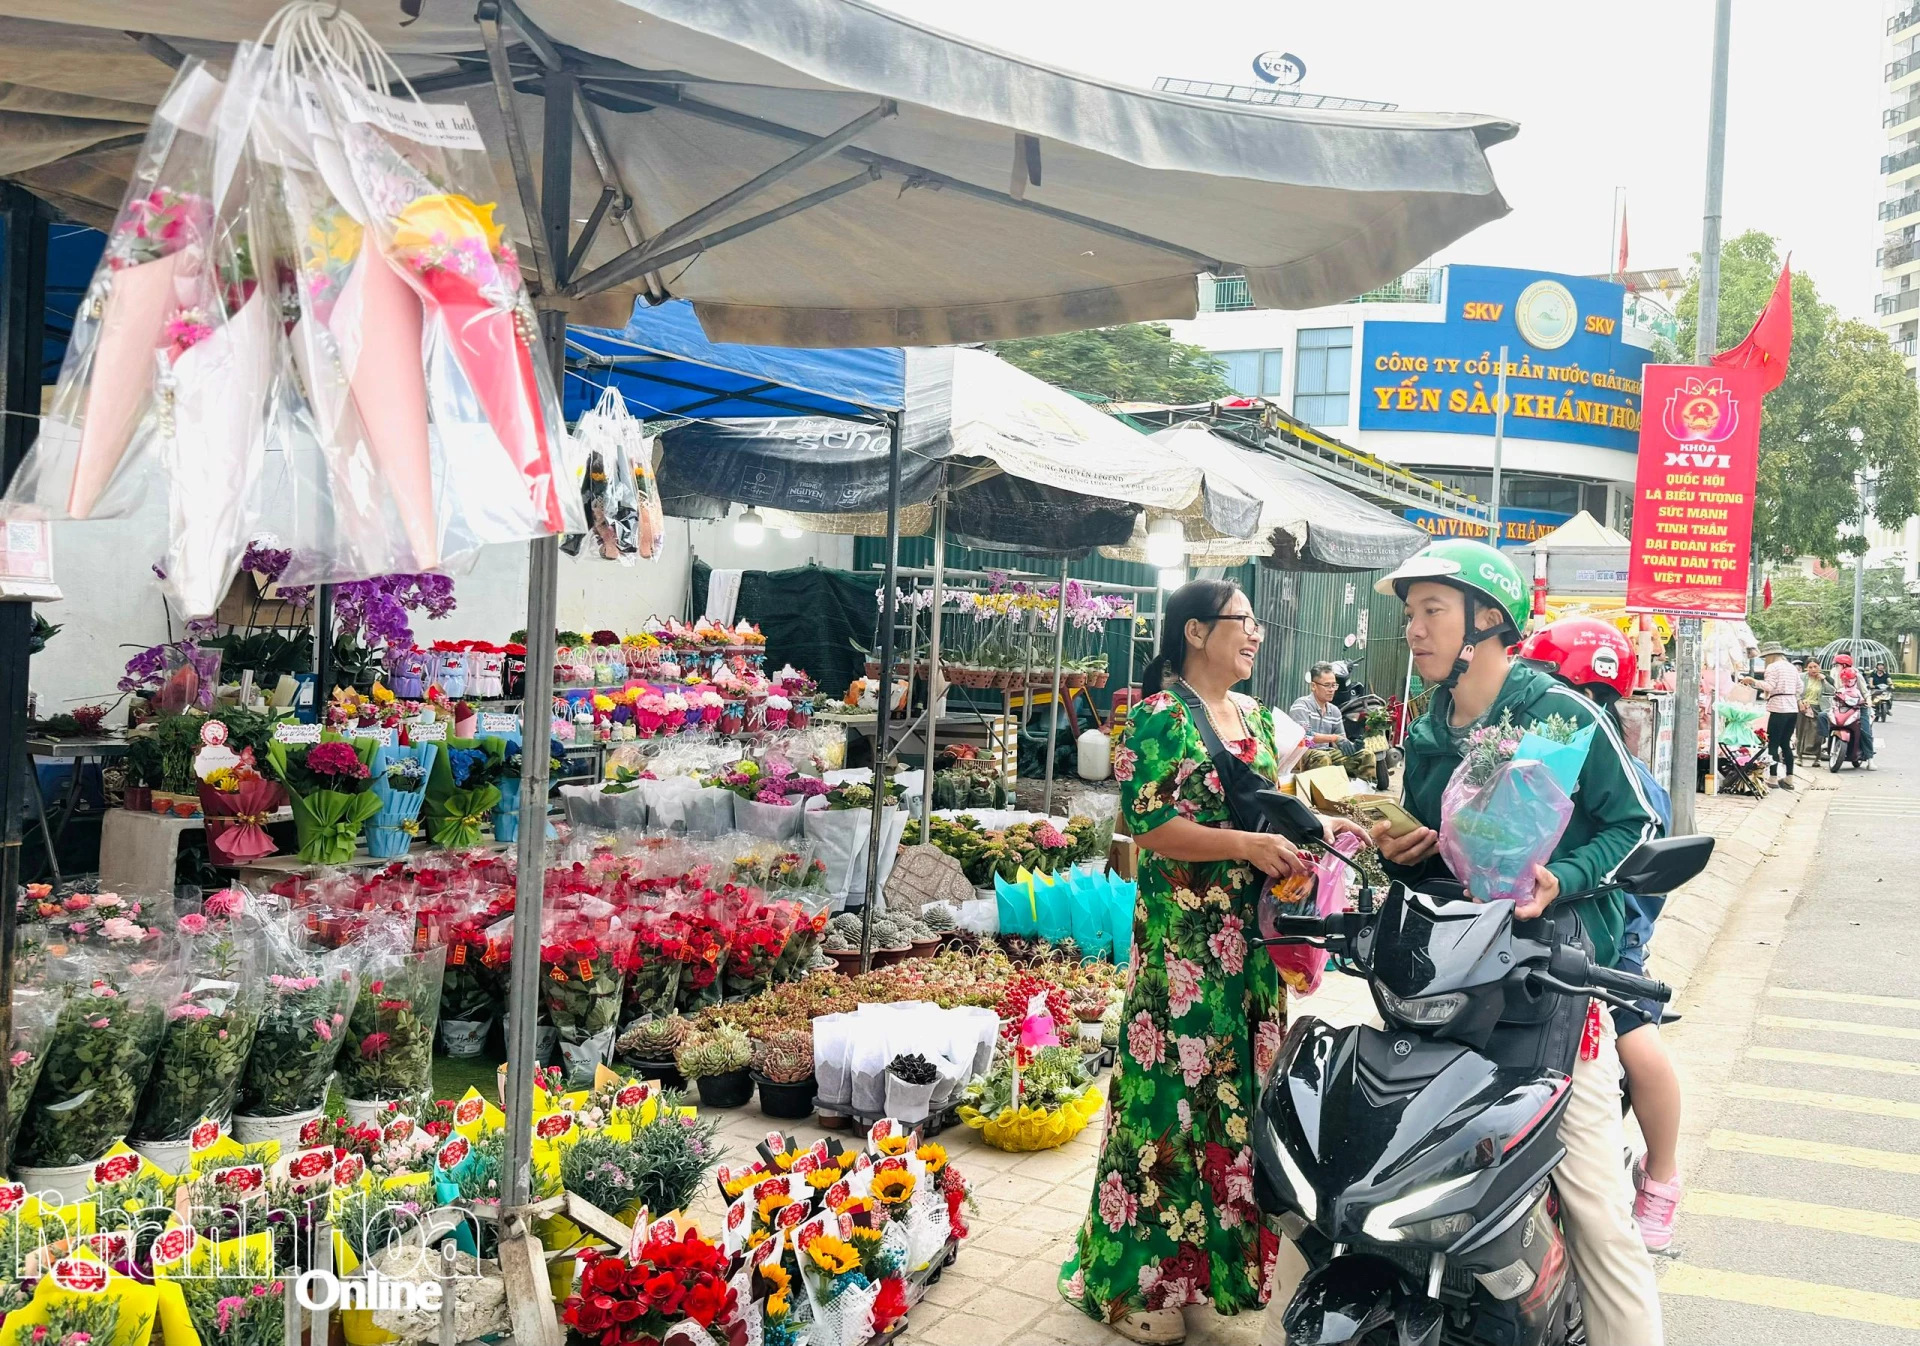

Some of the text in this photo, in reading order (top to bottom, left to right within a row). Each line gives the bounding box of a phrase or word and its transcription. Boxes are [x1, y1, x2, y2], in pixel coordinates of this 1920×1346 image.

[1263, 62, 1293, 73] VCN
[1463, 302, 1503, 322] SKV
[1585, 315, 1615, 336] SKV
[1375, 352, 1428, 373] CÔNG
[1434, 359, 1461, 374] TY
[1465, 351, 1491, 375] CỔ
[1547, 363, 1590, 385] NƯỚC
[1591, 368, 1622, 391] GIẢI
[1374, 376, 1442, 412] YẾN
[1449, 382, 1510, 416] SÀO
[1513, 390, 1611, 427] KHÁNH
[1679, 442, 1716, 453] KHÓA
[1663, 453, 1731, 469] XVI
[1094, 472, 1124, 482] LEGEND
[1666, 472, 1725, 487] QUỐC HỘI
[1645, 488, 1744, 505] LÀ BIỂU TƯỢNG
[1658, 504, 1729, 522] SỨC MẠNH
[1656, 521, 1728, 537] TINH THẦN
[1645, 538, 1736, 554] ĐẠI ĐOÀN KẾT
[1642, 553, 1737, 571] TOÀN DÂN TỘC
[1479, 563, 1522, 601] Grab
[1653, 569, 1722, 586] VIỆT NAM!
[552, 972, 564, 981] Tết
